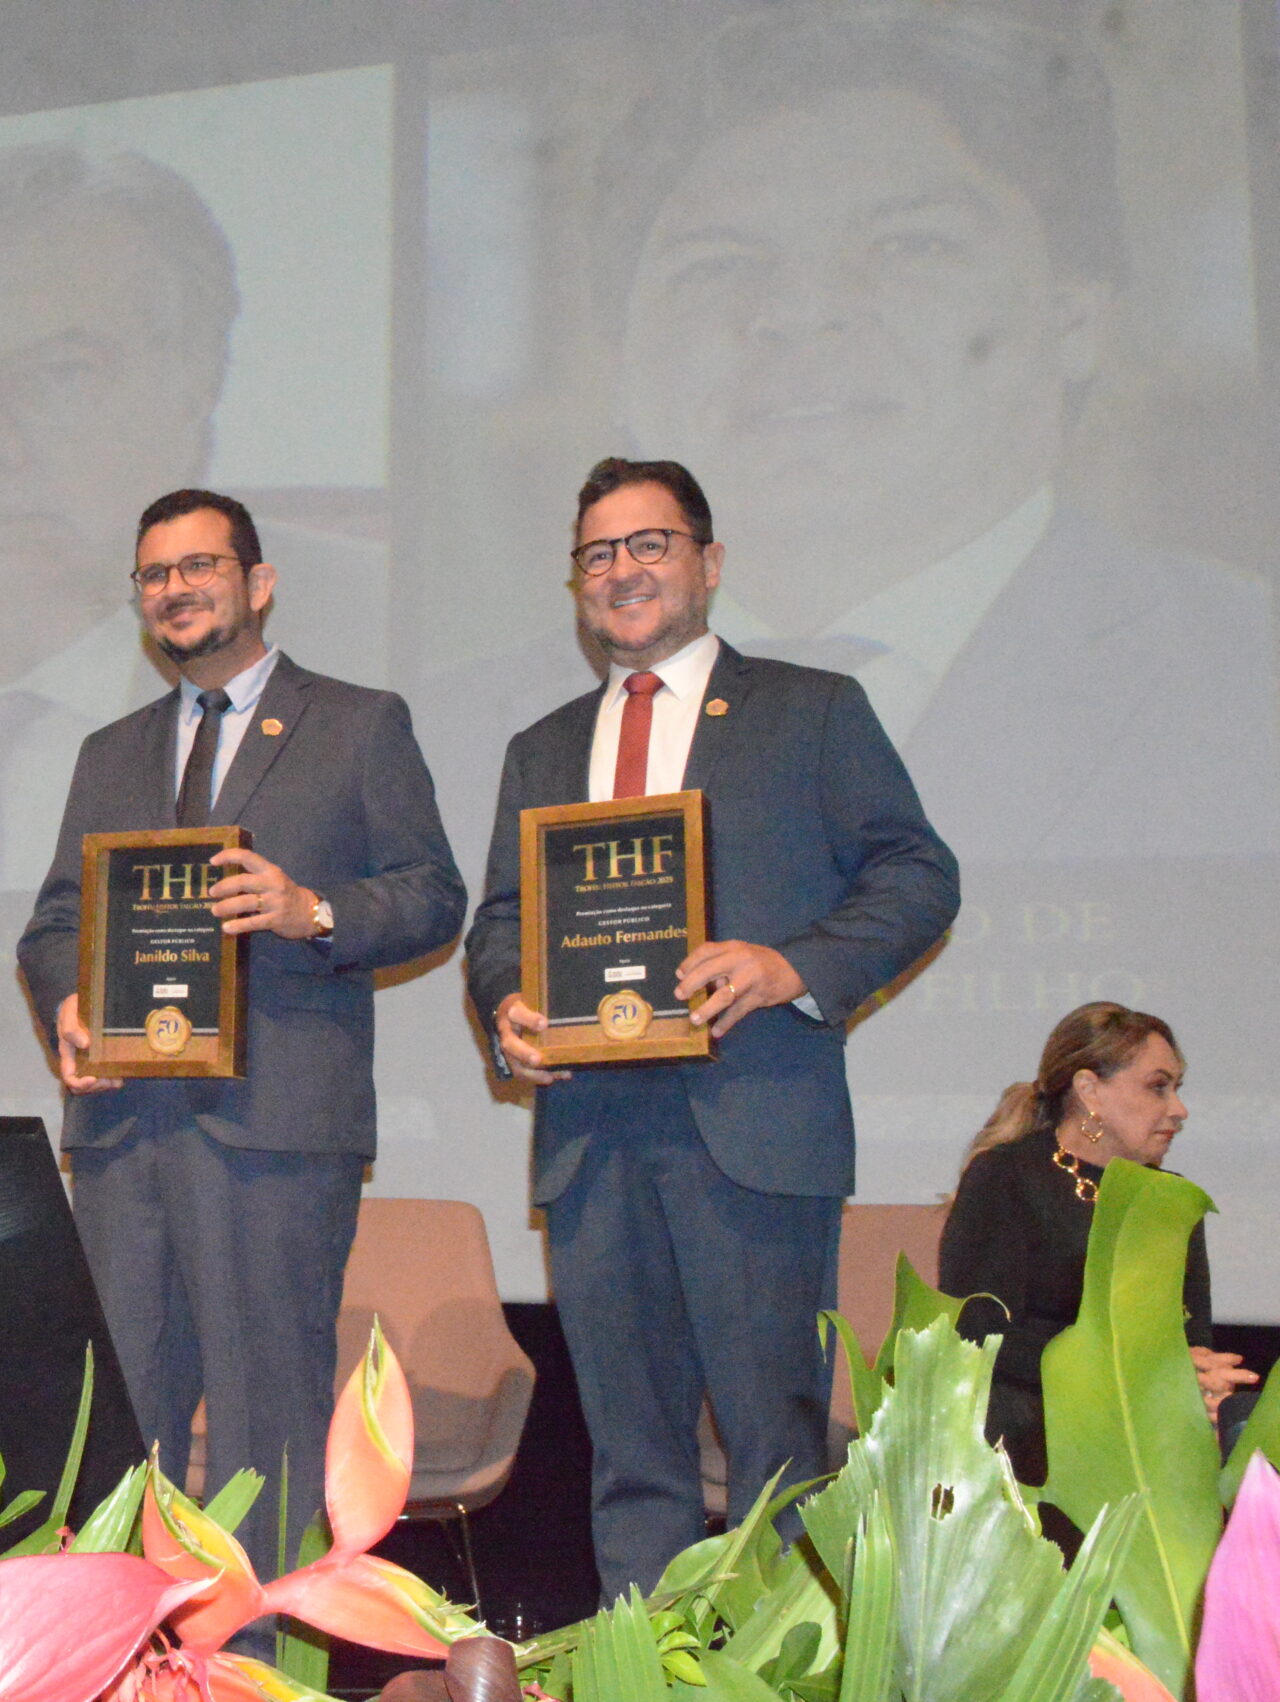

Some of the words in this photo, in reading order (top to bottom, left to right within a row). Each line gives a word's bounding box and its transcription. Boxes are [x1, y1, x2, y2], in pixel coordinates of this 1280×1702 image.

[573, 834, 674, 881] THF
[131, 863, 218, 900] THF
[561, 934, 612, 949] Adauto
[615, 925, 688, 944] Fernandes
[134, 949, 178, 965] Janildo
[181, 948, 211, 962] Silva
